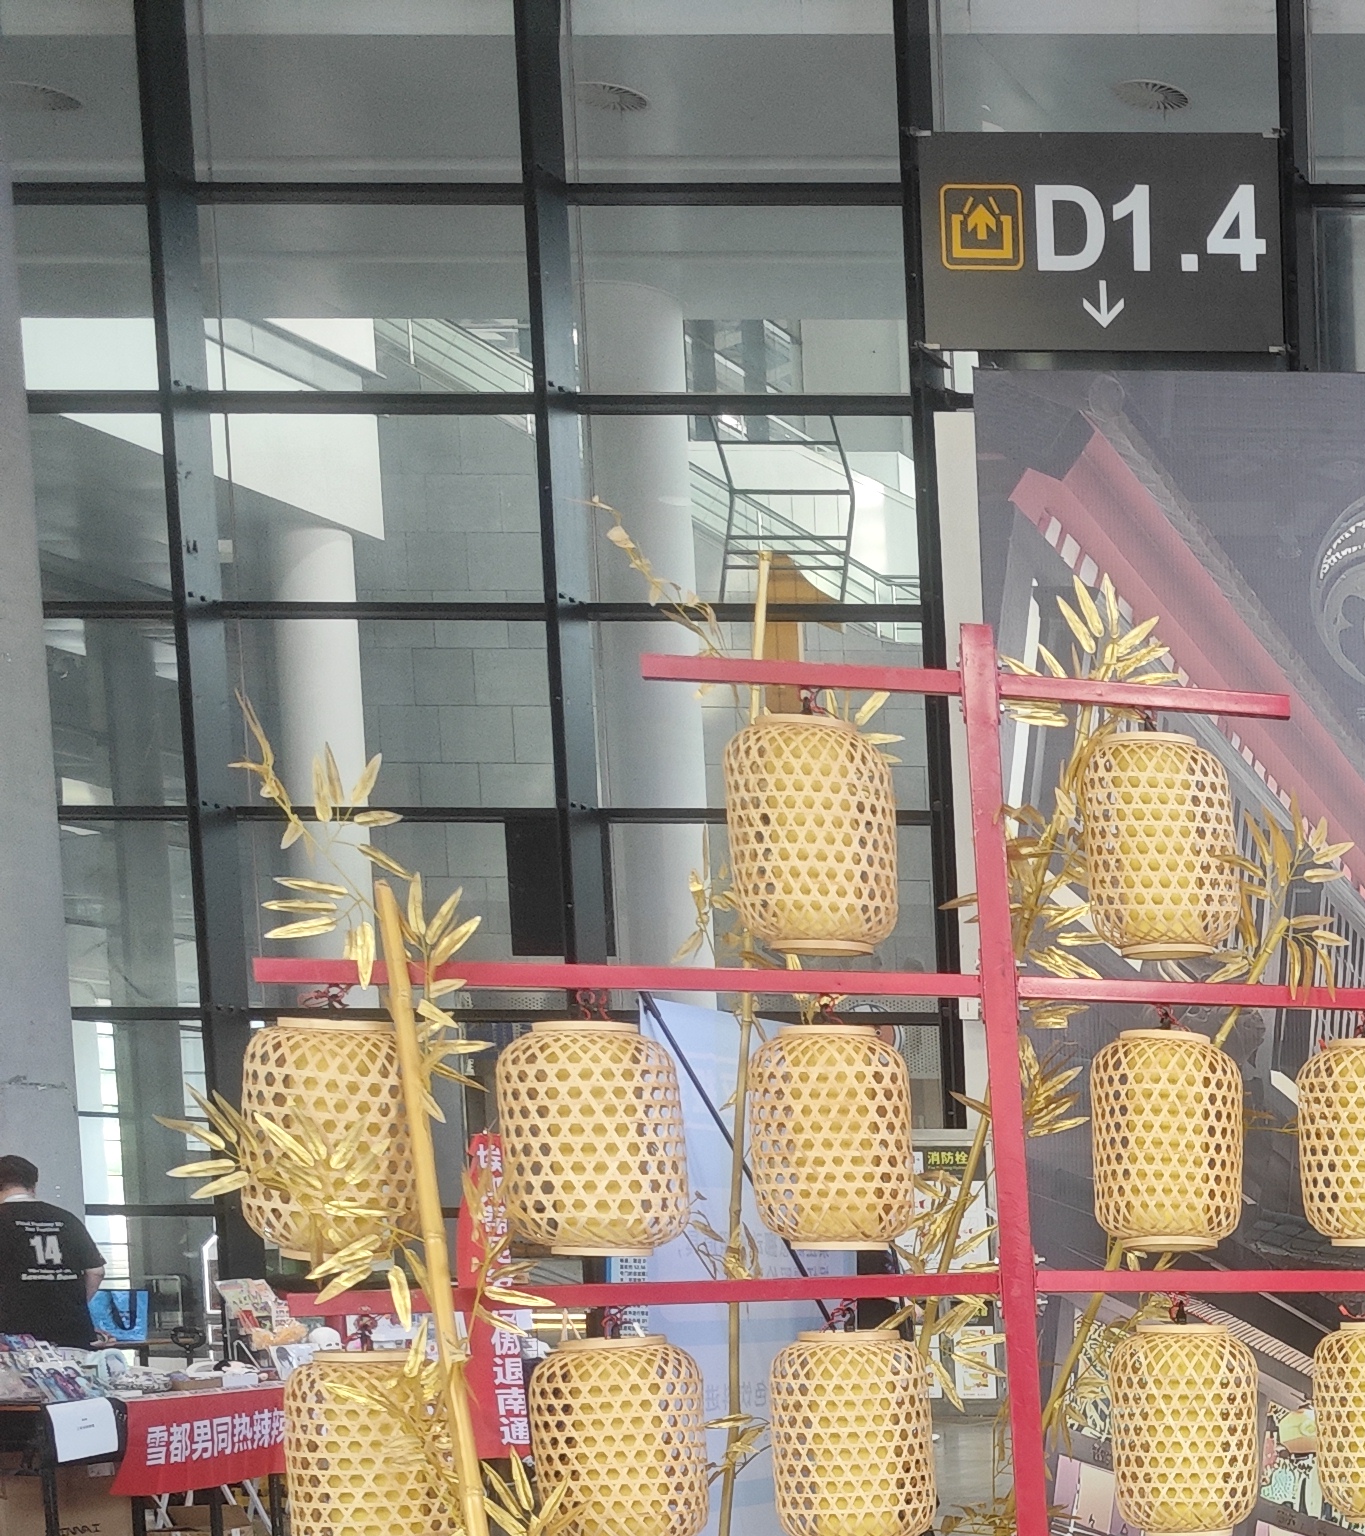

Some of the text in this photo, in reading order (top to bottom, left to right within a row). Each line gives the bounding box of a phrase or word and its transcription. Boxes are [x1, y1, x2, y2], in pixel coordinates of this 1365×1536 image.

[1035, 184, 1267, 272] D1.4
[927, 1151, 968, 1165] 消防栓
[29, 1235, 62, 1265] 14
